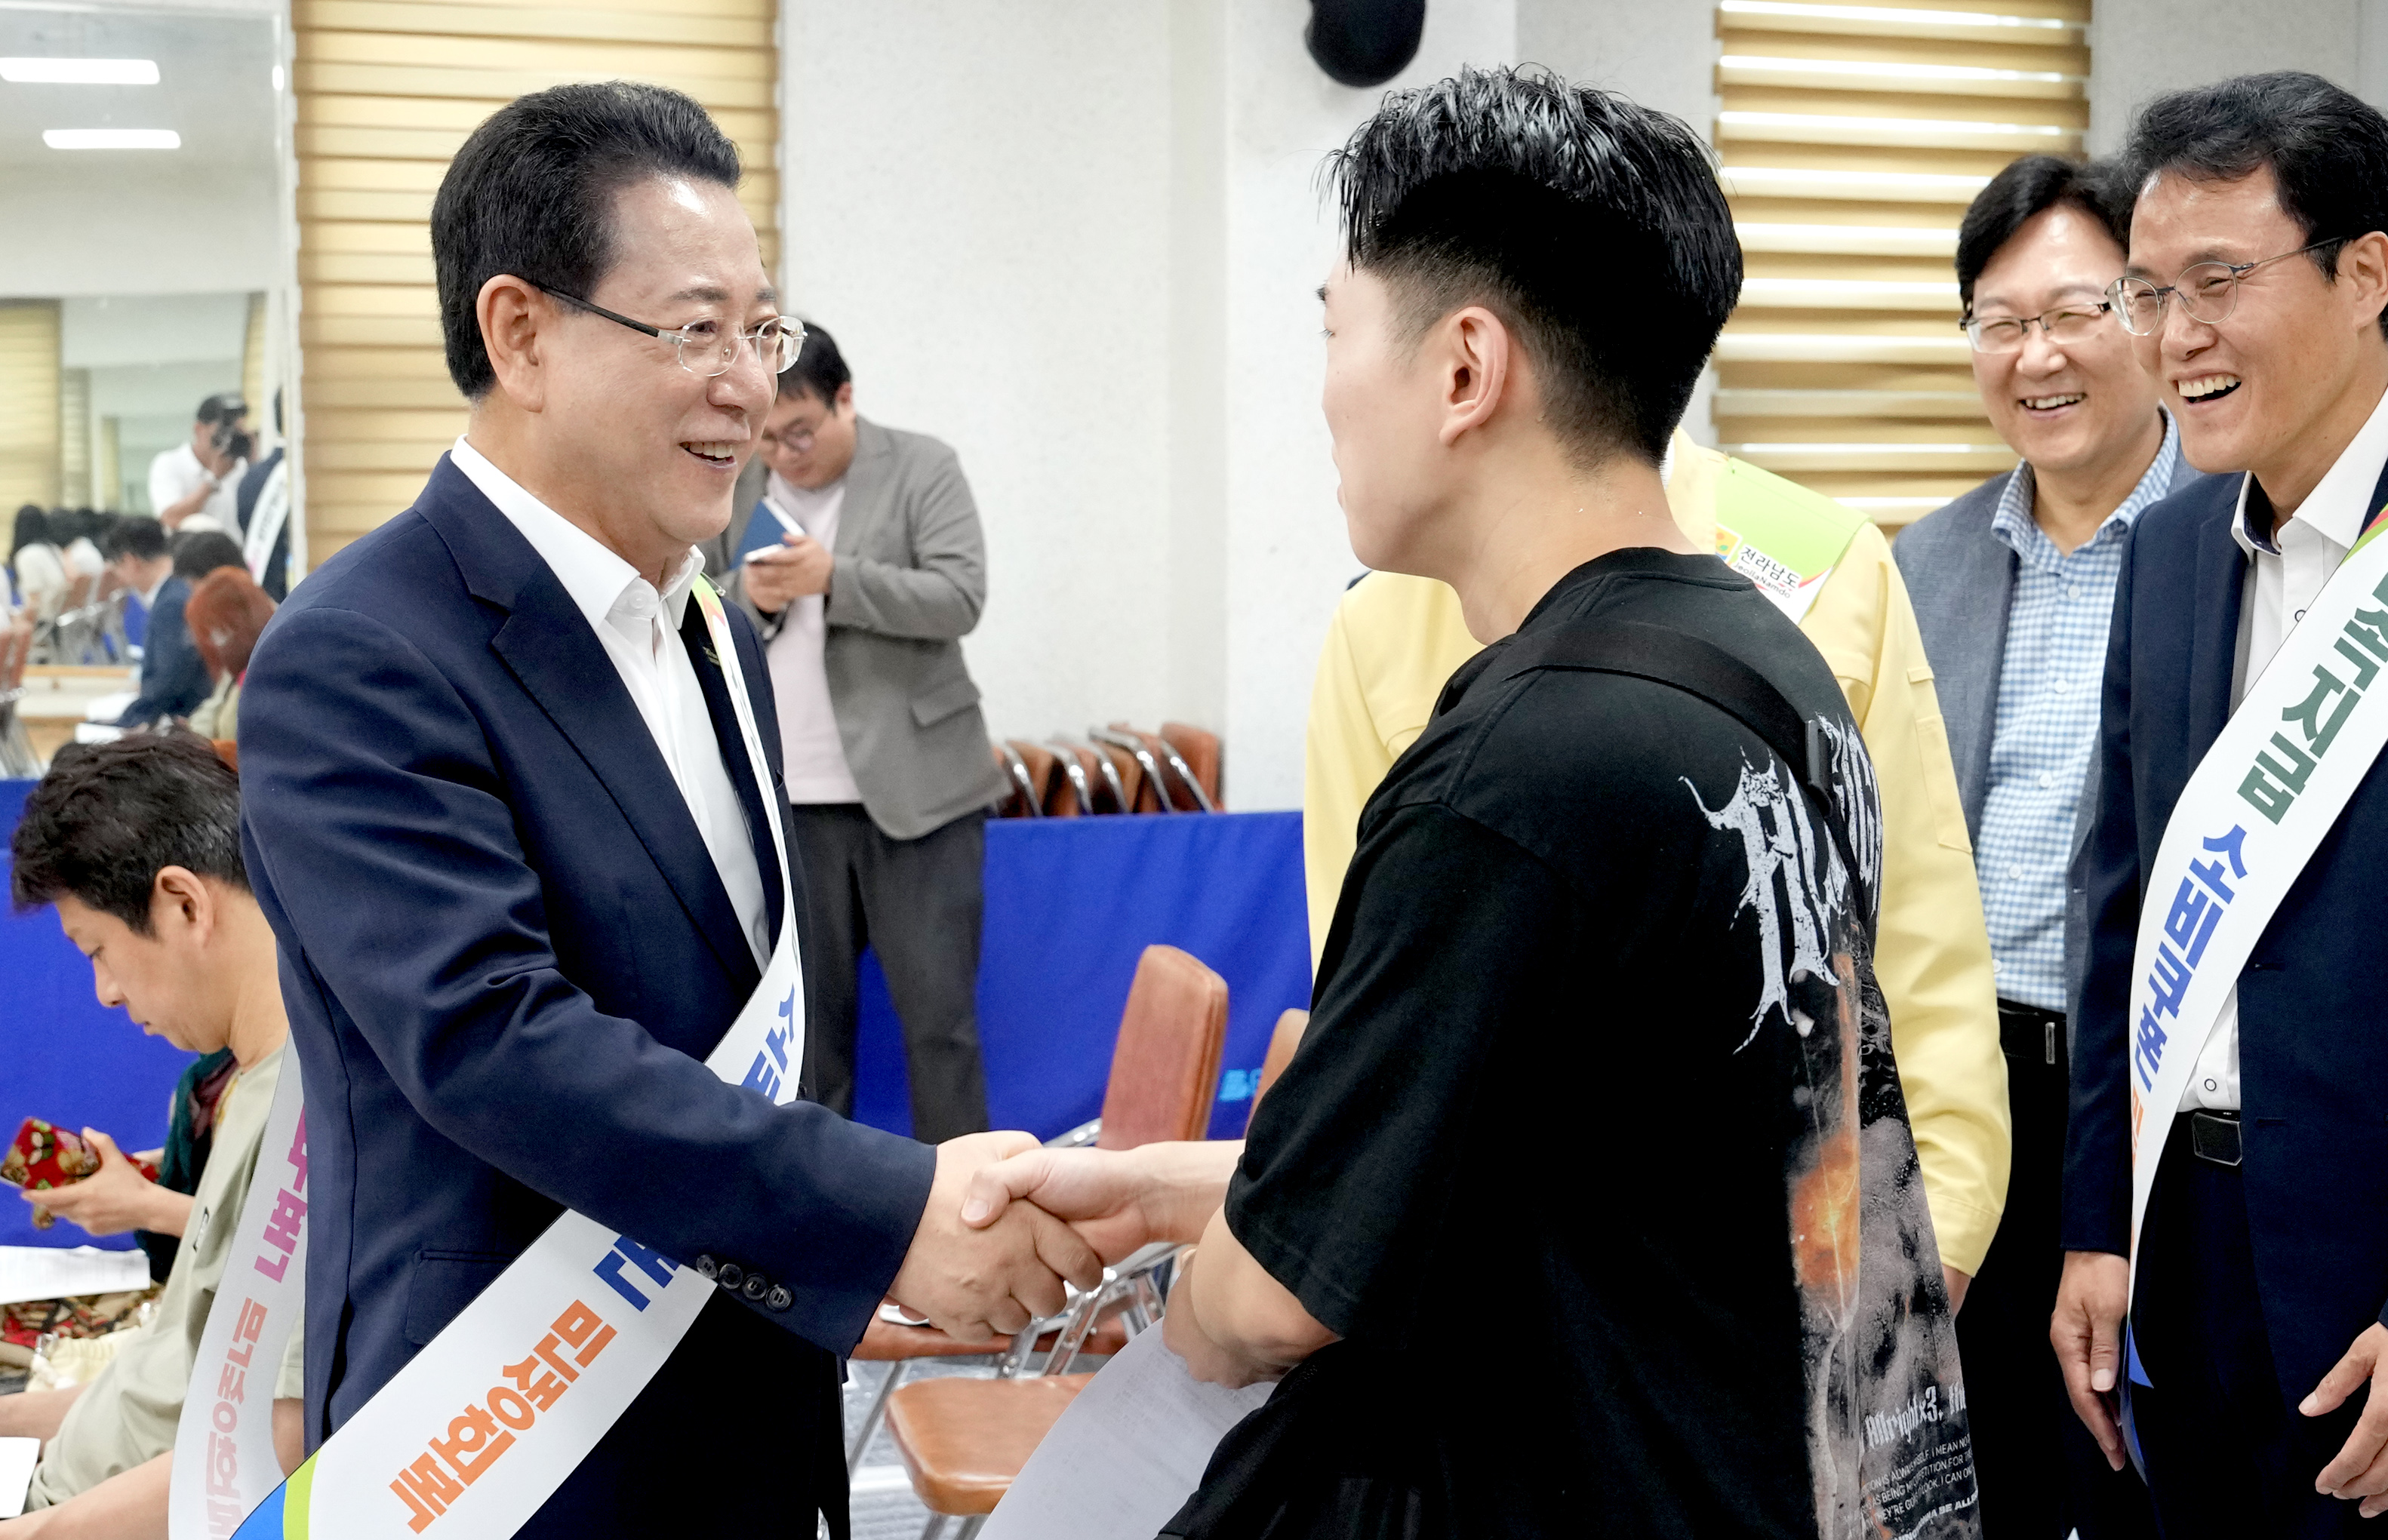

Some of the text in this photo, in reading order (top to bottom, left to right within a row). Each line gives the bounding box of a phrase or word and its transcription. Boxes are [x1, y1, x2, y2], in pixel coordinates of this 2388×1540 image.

[1740, 546, 1799, 589] 전라남도
[2134, 571, 2388, 1093] 속지급 소비쿠폰
[389, 1299, 618, 1535] 민생회복
[1935, 1440, 1959, 1456] MEAN
[1881, 1484, 1906, 1504] BEING
[1948, 1454, 1964, 1468] FOR
[1945, 1470, 1963, 1485] CAN
